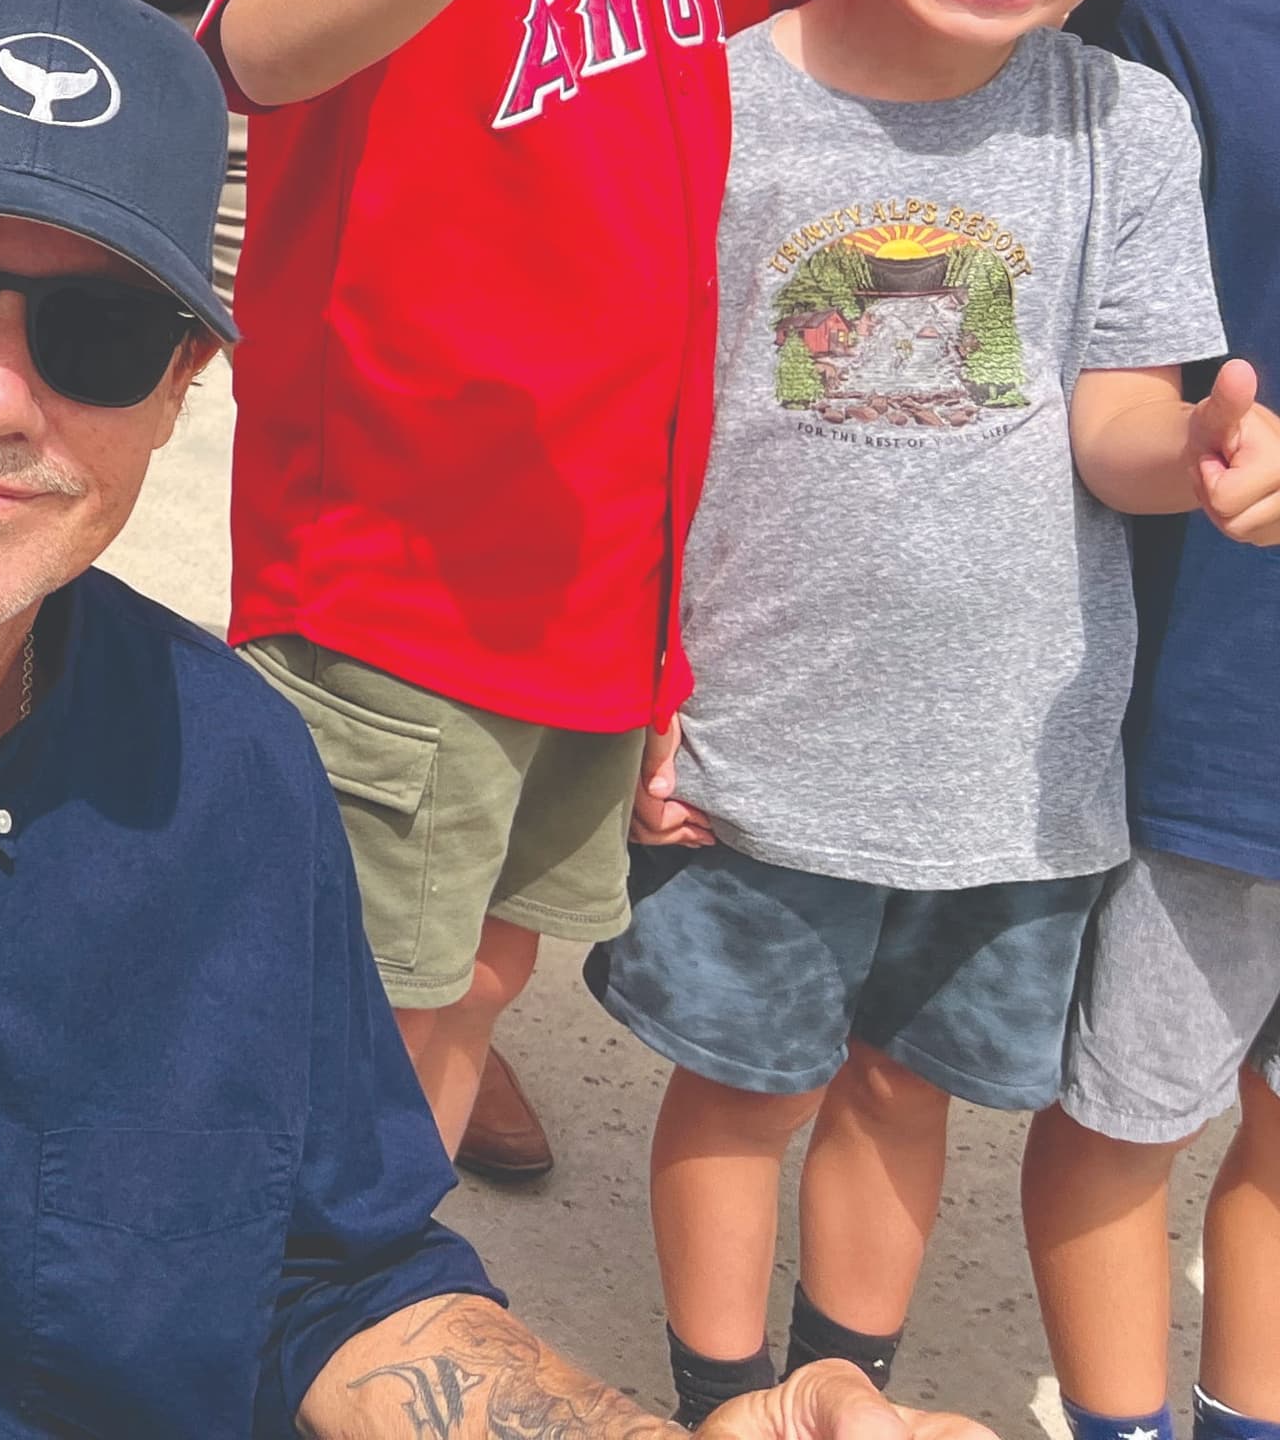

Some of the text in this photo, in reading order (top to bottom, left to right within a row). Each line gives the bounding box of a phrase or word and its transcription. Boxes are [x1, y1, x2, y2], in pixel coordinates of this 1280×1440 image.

[767, 197, 1033, 278] TRINITY ALPS RESORT
[797, 421, 826, 437] FOR
[831, 430, 857, 444] THE
[865, 436, 901, 448] REST
[907, 438, 925, 449] OF
[982, 424, 1010, 441] LIFE
